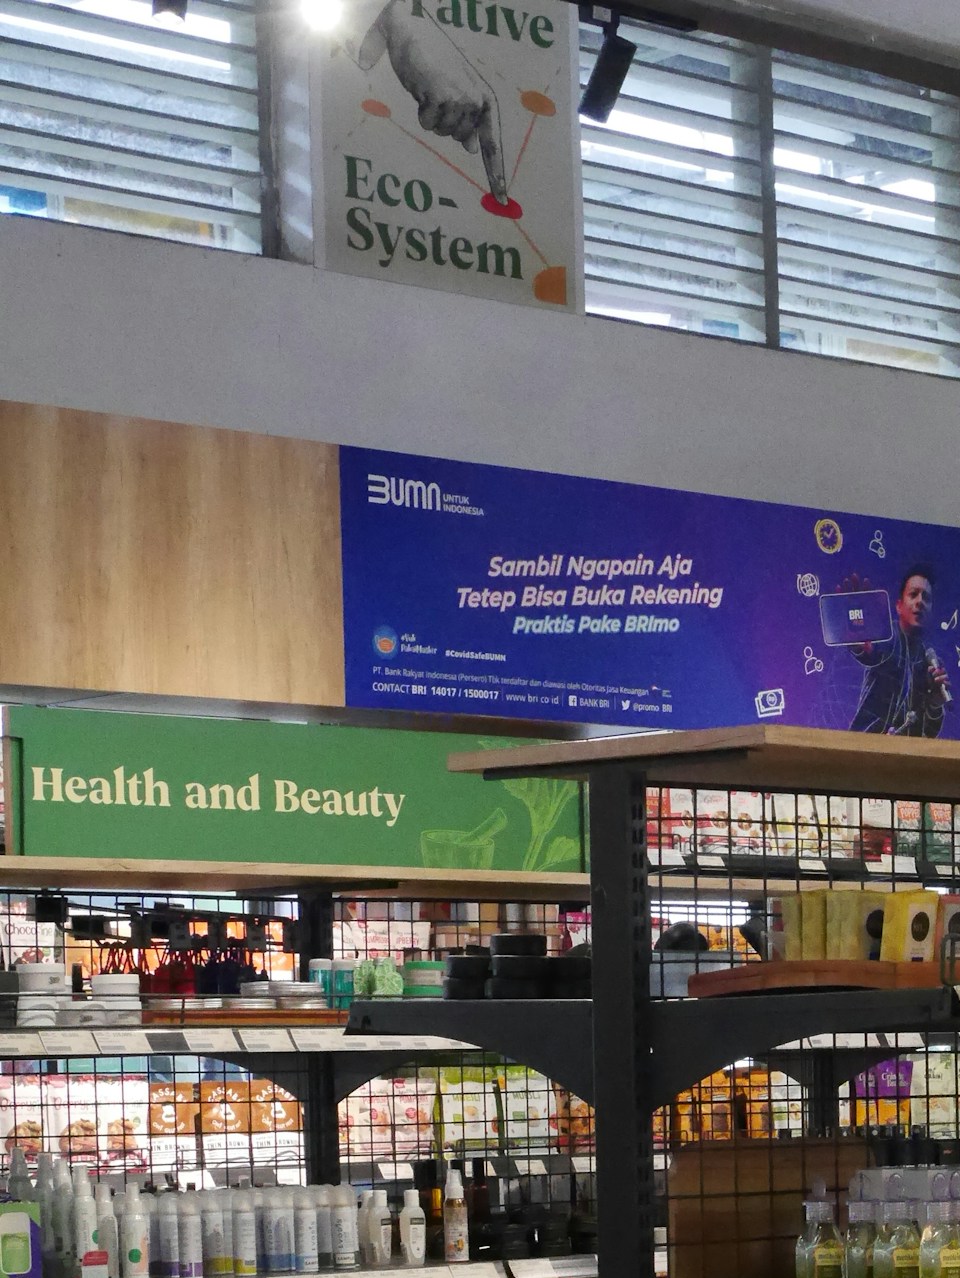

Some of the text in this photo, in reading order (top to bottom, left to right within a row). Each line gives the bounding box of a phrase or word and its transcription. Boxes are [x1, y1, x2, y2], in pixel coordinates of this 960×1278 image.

[344, 154, 459, 213] Eco-
[346, 206, 524, 281] System
[443, 493, 469, 505] UNTUK
[443, 503, 484, 516] INDONESIA
[488, 553, 692, 580] Sambil Ngapain Aja
[457, 582, 724, 612] Tetep Bisa Buka Rekening
[848, 609, 864, 620] BRI
[513, 614, 680, 635] Praktis Pake BRImo
[384, 667, 402, 677] Bank
[402, 668, 424, 680] Rakyat
[425, 671, 457, 681] Indonesia
[372, 682, 410, 694] CONTACT
[411, 684, 427, 695] BRI
[430, 686, 457, 697] 14017
[463, 688, 499, 700] 1500017
[579, 697, 610, 708] BANK BRI
[32, 766, 406, 828] Health and Beauty
